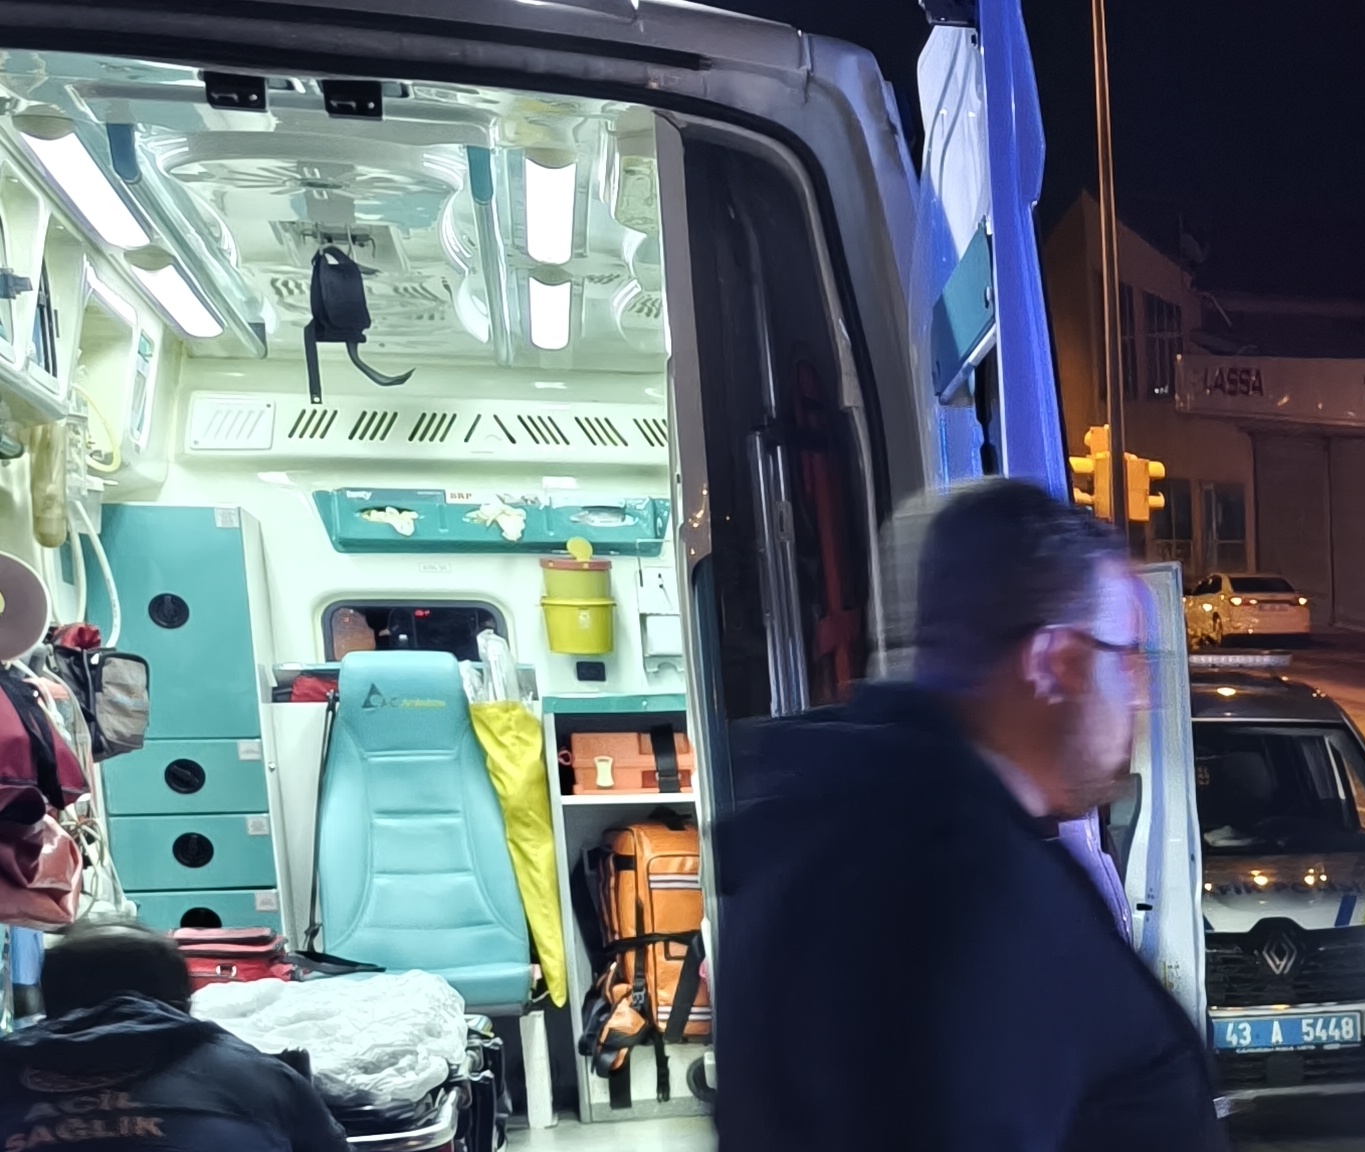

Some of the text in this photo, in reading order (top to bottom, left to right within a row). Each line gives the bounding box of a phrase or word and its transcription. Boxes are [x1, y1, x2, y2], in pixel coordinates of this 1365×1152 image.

[1225, 1015, 1355, 1046] 43 A 5448
